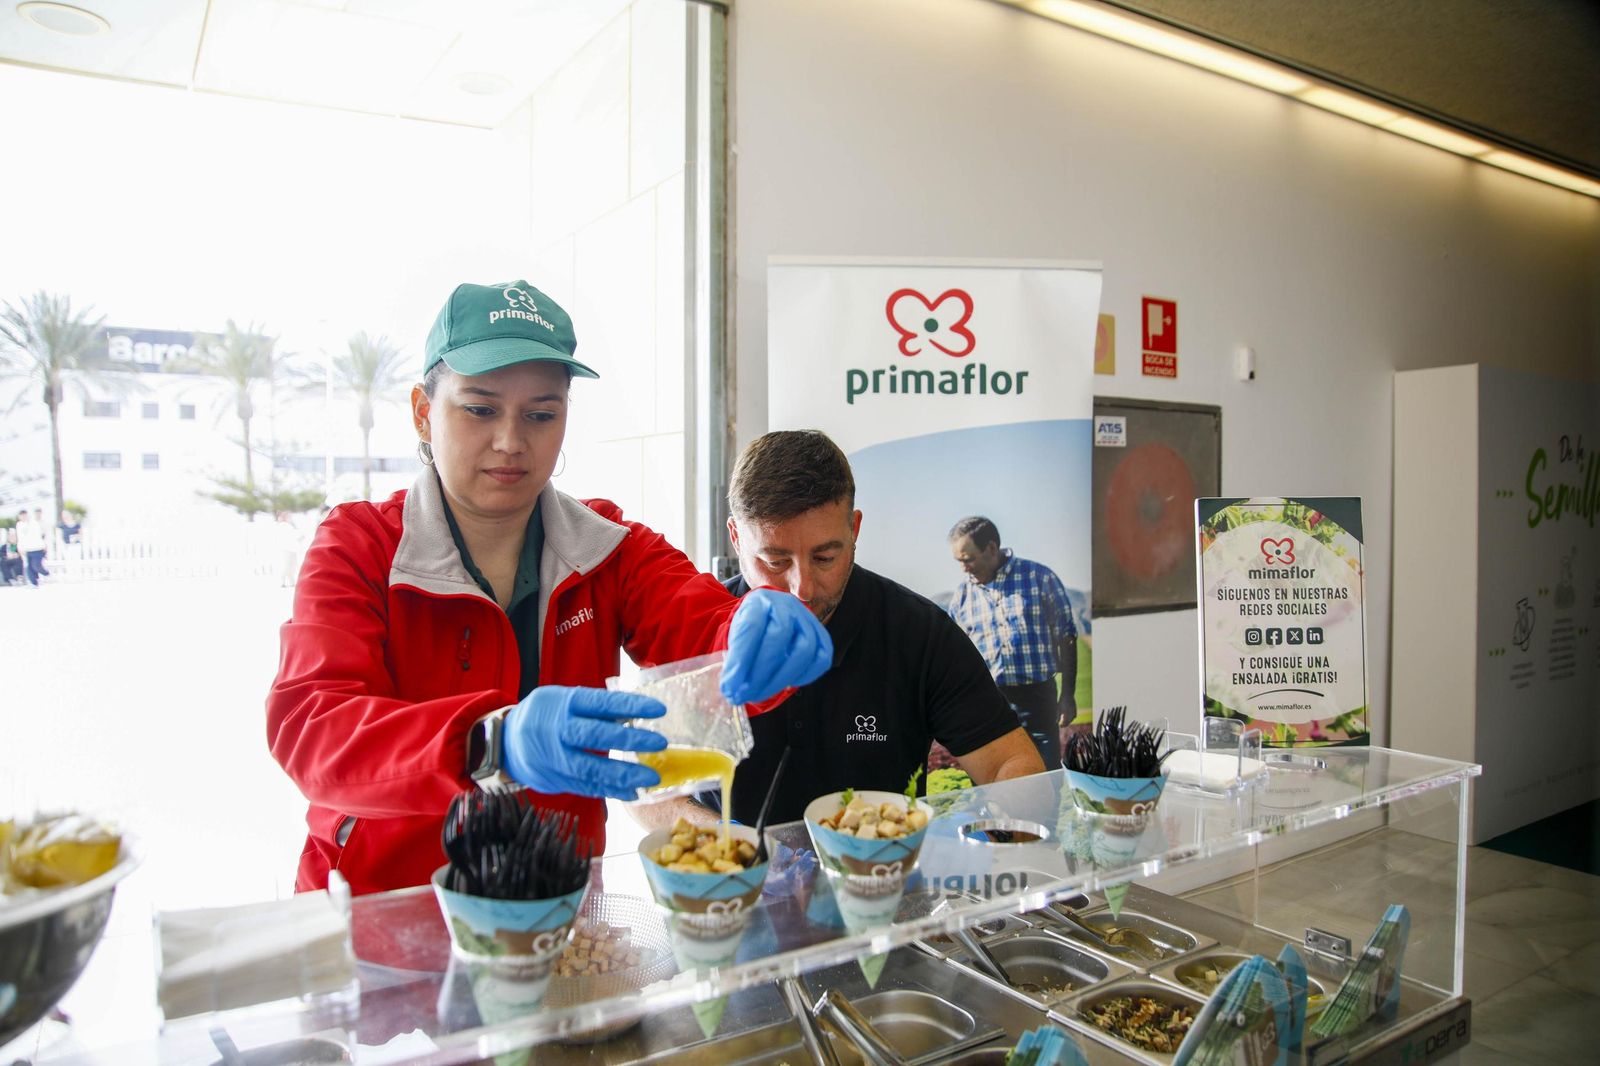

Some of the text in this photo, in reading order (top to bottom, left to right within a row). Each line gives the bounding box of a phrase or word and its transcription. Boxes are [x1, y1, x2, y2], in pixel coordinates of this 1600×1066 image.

[489, 308, 555, 332] primaflor
[846, 363, 1029, 405] primaflor
[1525, 448, 1600, 528] Semill
[1248, 566, 1316, 580] mimaflor
[1217, 586, 1348, 601] SÍGUENOS EN NUESTRAS
[1240, 602, 1327, 616] REDES SOCIALES
[1239, 656, 1330, 669] Y CONSIGUE UNA
[1232, 671, 1338, 685] ENSALADA ¡GRATIS!
[1257, 703, 1312, 711] www.mimaflor.es
[846, 732, 888, 743] primaflor
